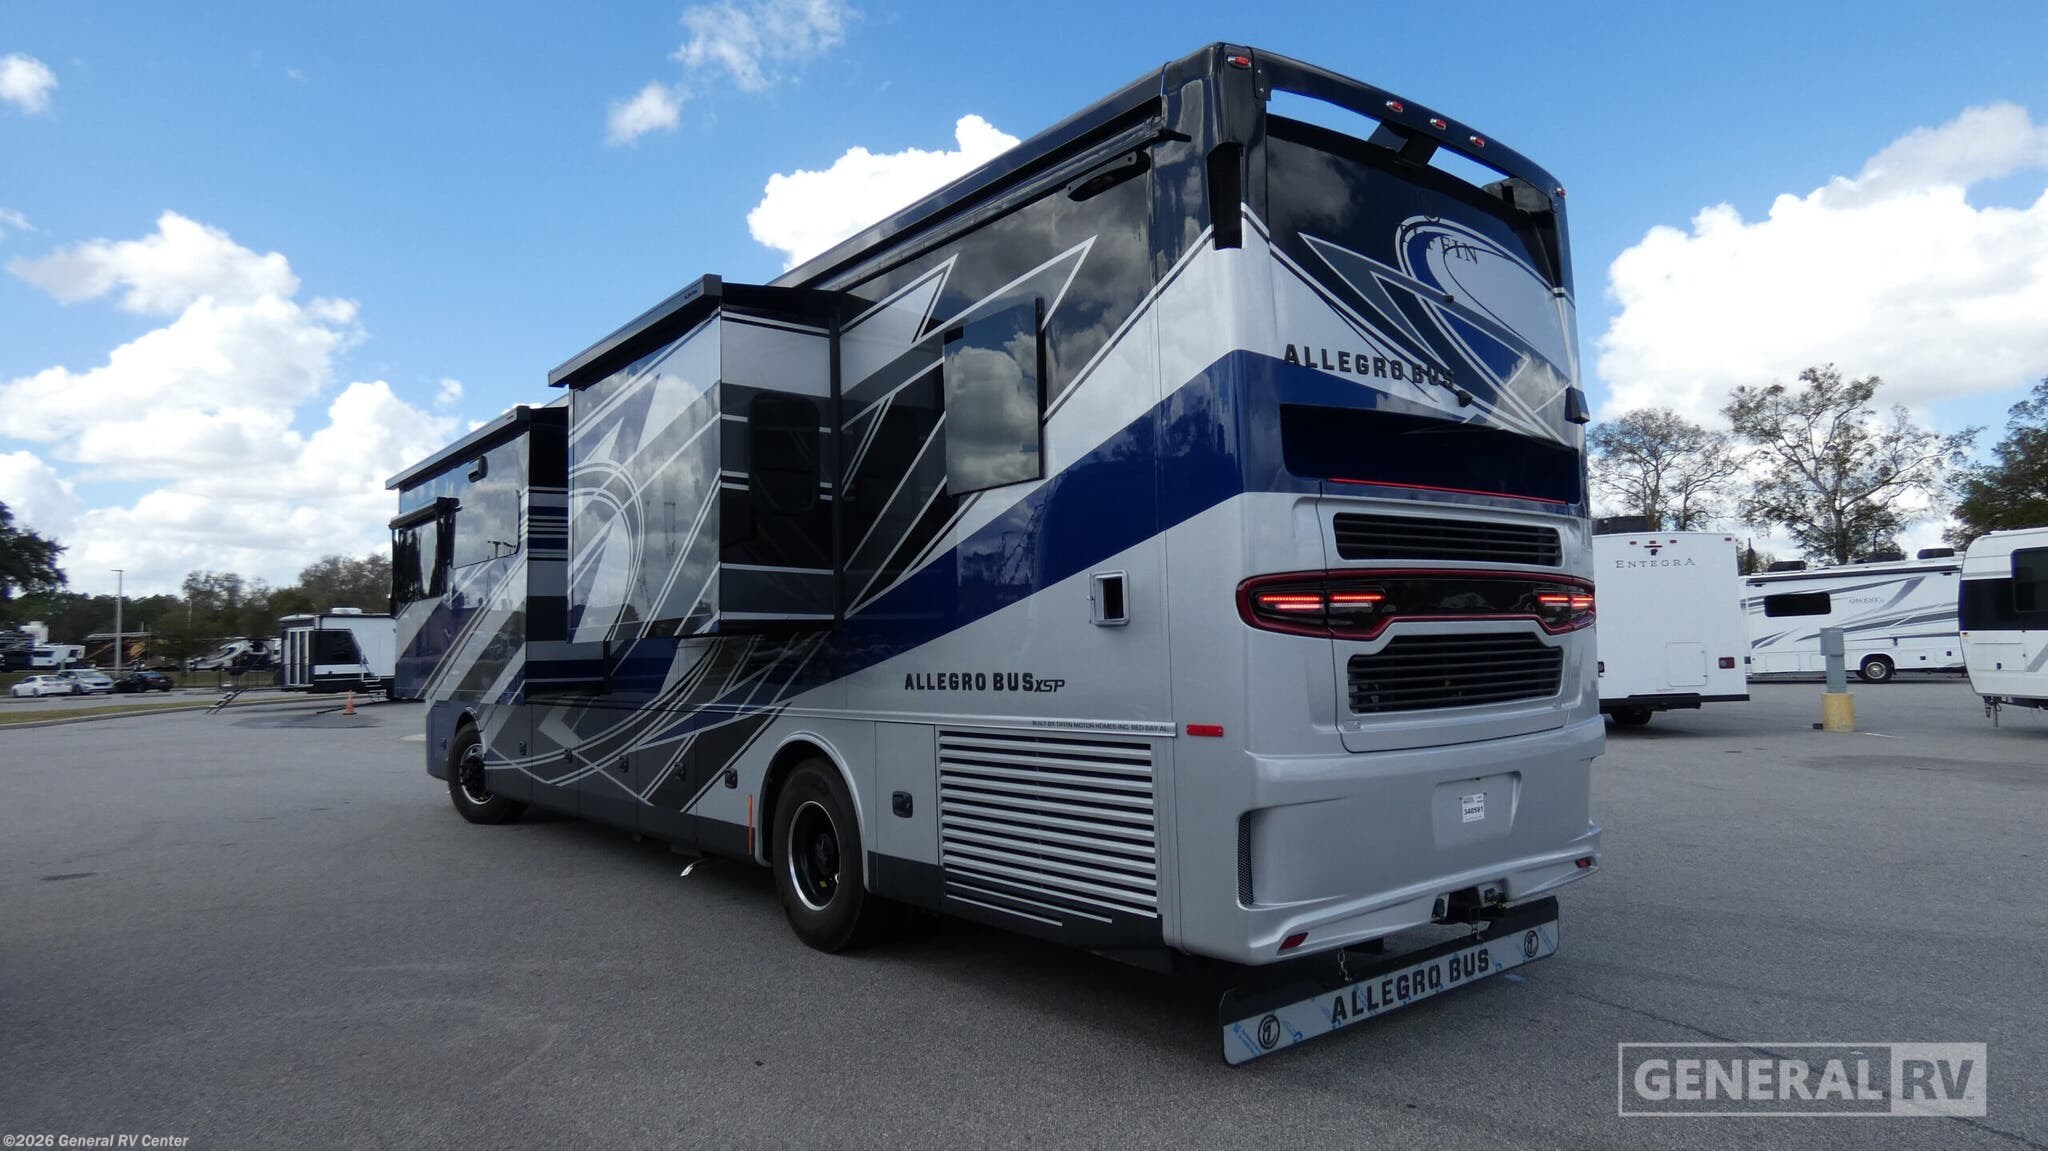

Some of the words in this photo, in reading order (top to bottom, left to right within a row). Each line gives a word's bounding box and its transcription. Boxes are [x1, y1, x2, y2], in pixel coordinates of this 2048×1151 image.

[1284, 344, 1404, 380] ALLEGRO
[1411, 363, 1455, 388] BUS
[1616, 558, 1696, 568] ENTEGRA
[904, 673, 986, 691] ALLEGRO
[993, 673, 1034, 691] BUS
[1034, 679, 1066, 692] XSP
[1331, 964, 1441, 1024] ALLEGRO
[1449, 948, 1490, 983] BUS
